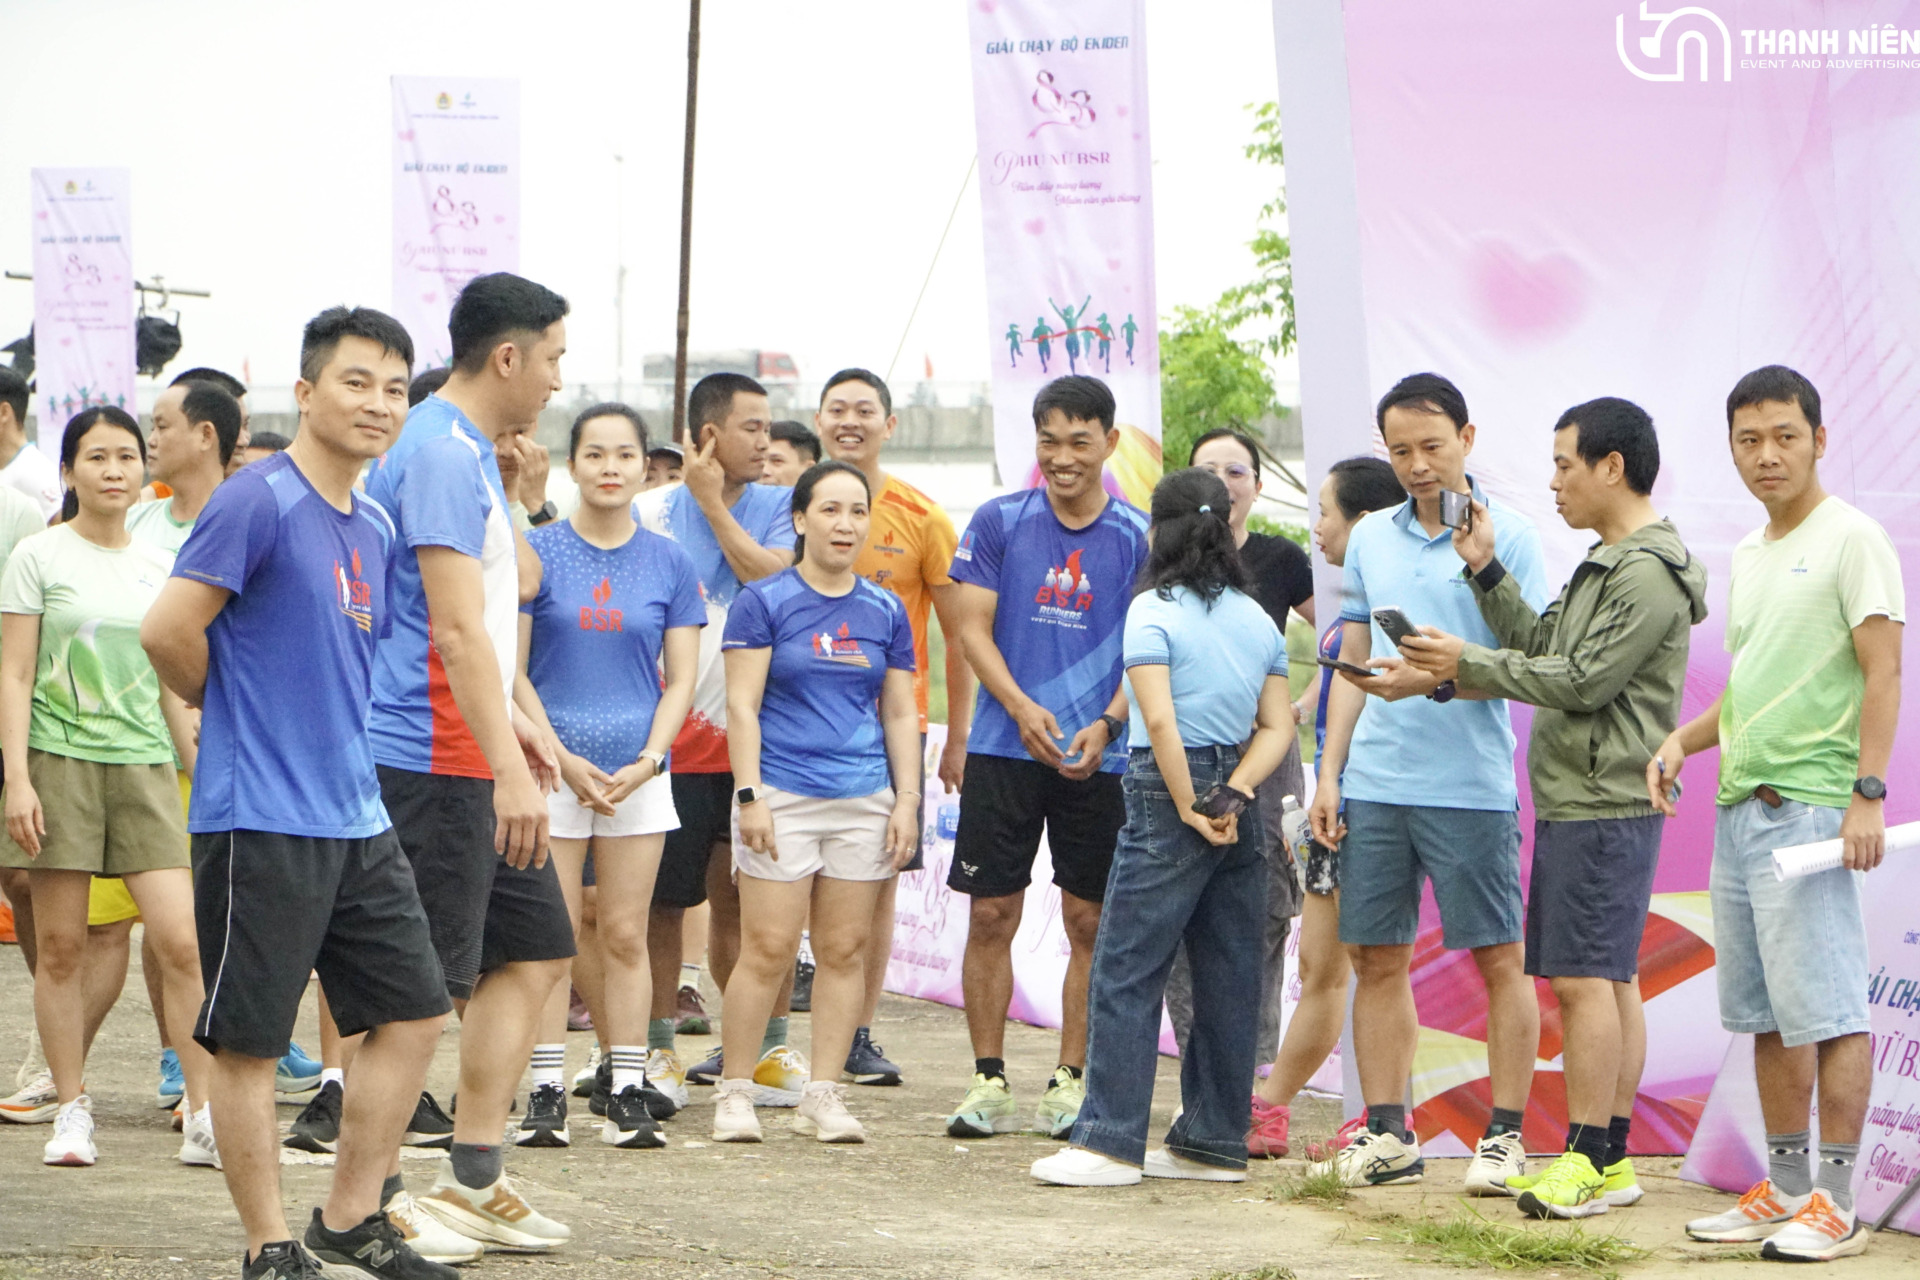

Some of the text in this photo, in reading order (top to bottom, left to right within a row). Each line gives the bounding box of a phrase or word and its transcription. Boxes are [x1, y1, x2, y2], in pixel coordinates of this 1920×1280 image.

[1019, 39, 1055, 56] CHẠY
[1060, 35, 1079, 53] BỘ
[1084, 36, 1129, 50] EKIDEN
[1077, 151, 1110, 165] BSR
[1035, 585, 1094, 611] BSR
[579, 606, 623, 632] BSR
[1038, 605, 1083, 621] RUNNERS
[354, 1238, 395, 1269] N
